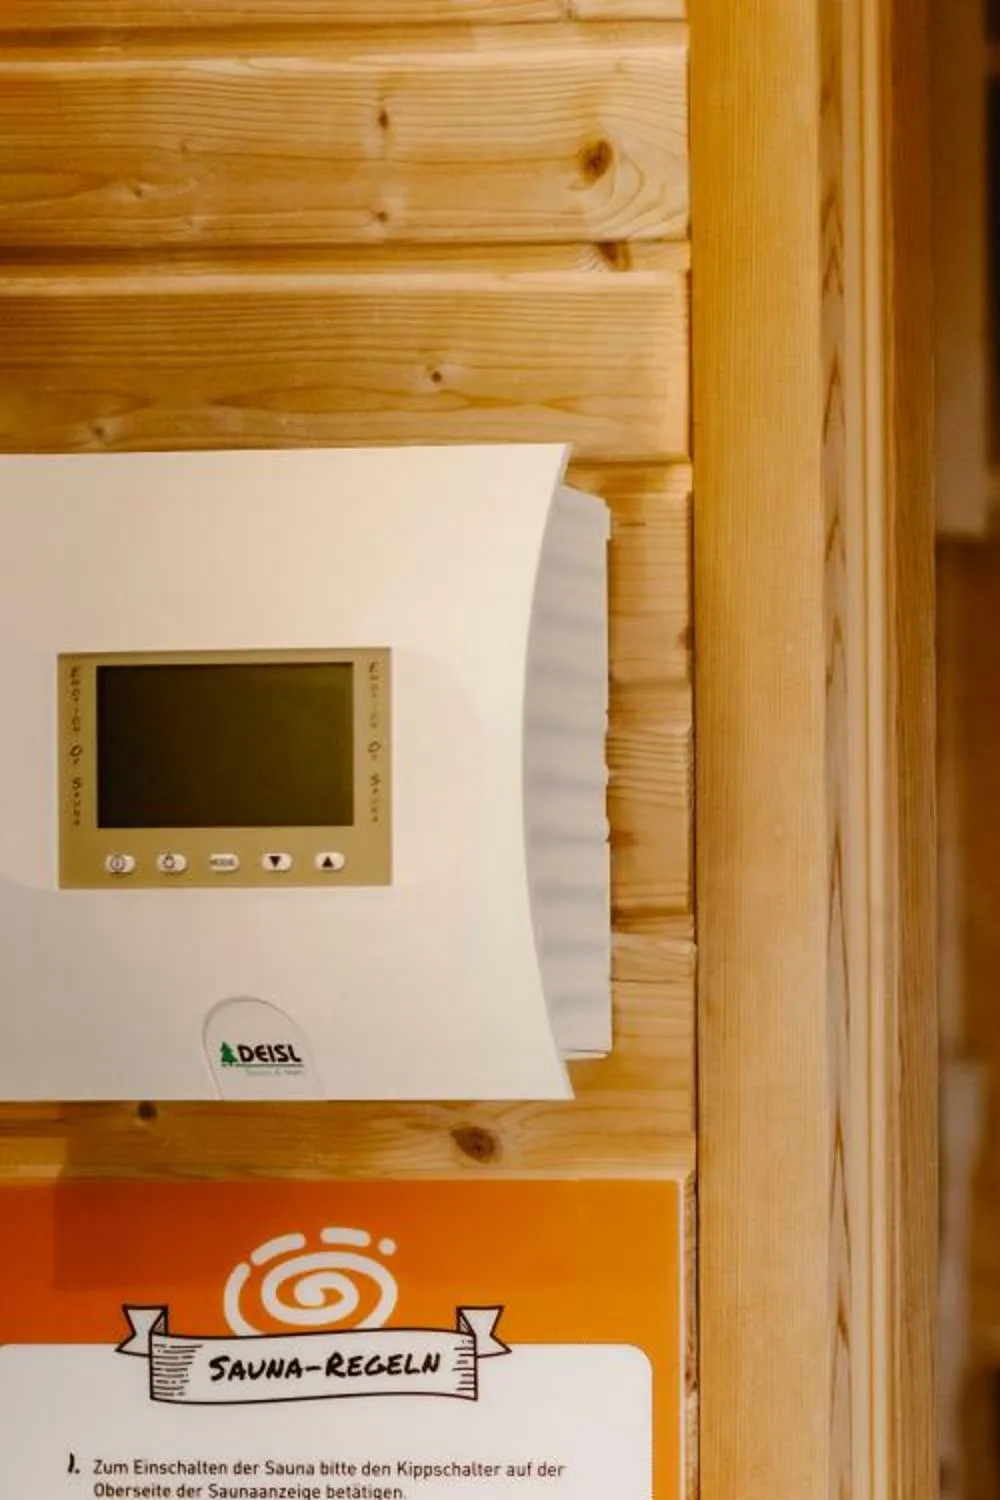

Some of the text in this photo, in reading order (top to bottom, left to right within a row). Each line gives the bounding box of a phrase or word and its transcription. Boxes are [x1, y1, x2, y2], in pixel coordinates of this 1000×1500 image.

[237, 1044, 302, 1063] DEISL
[67, 1453, 565, 1480] 1. Zum Einschalten der Sauna bitte den Kippschalter auf der
[93, 1482, 171, 1498] Oberseite
[176, 1484, 203, 1498] der
